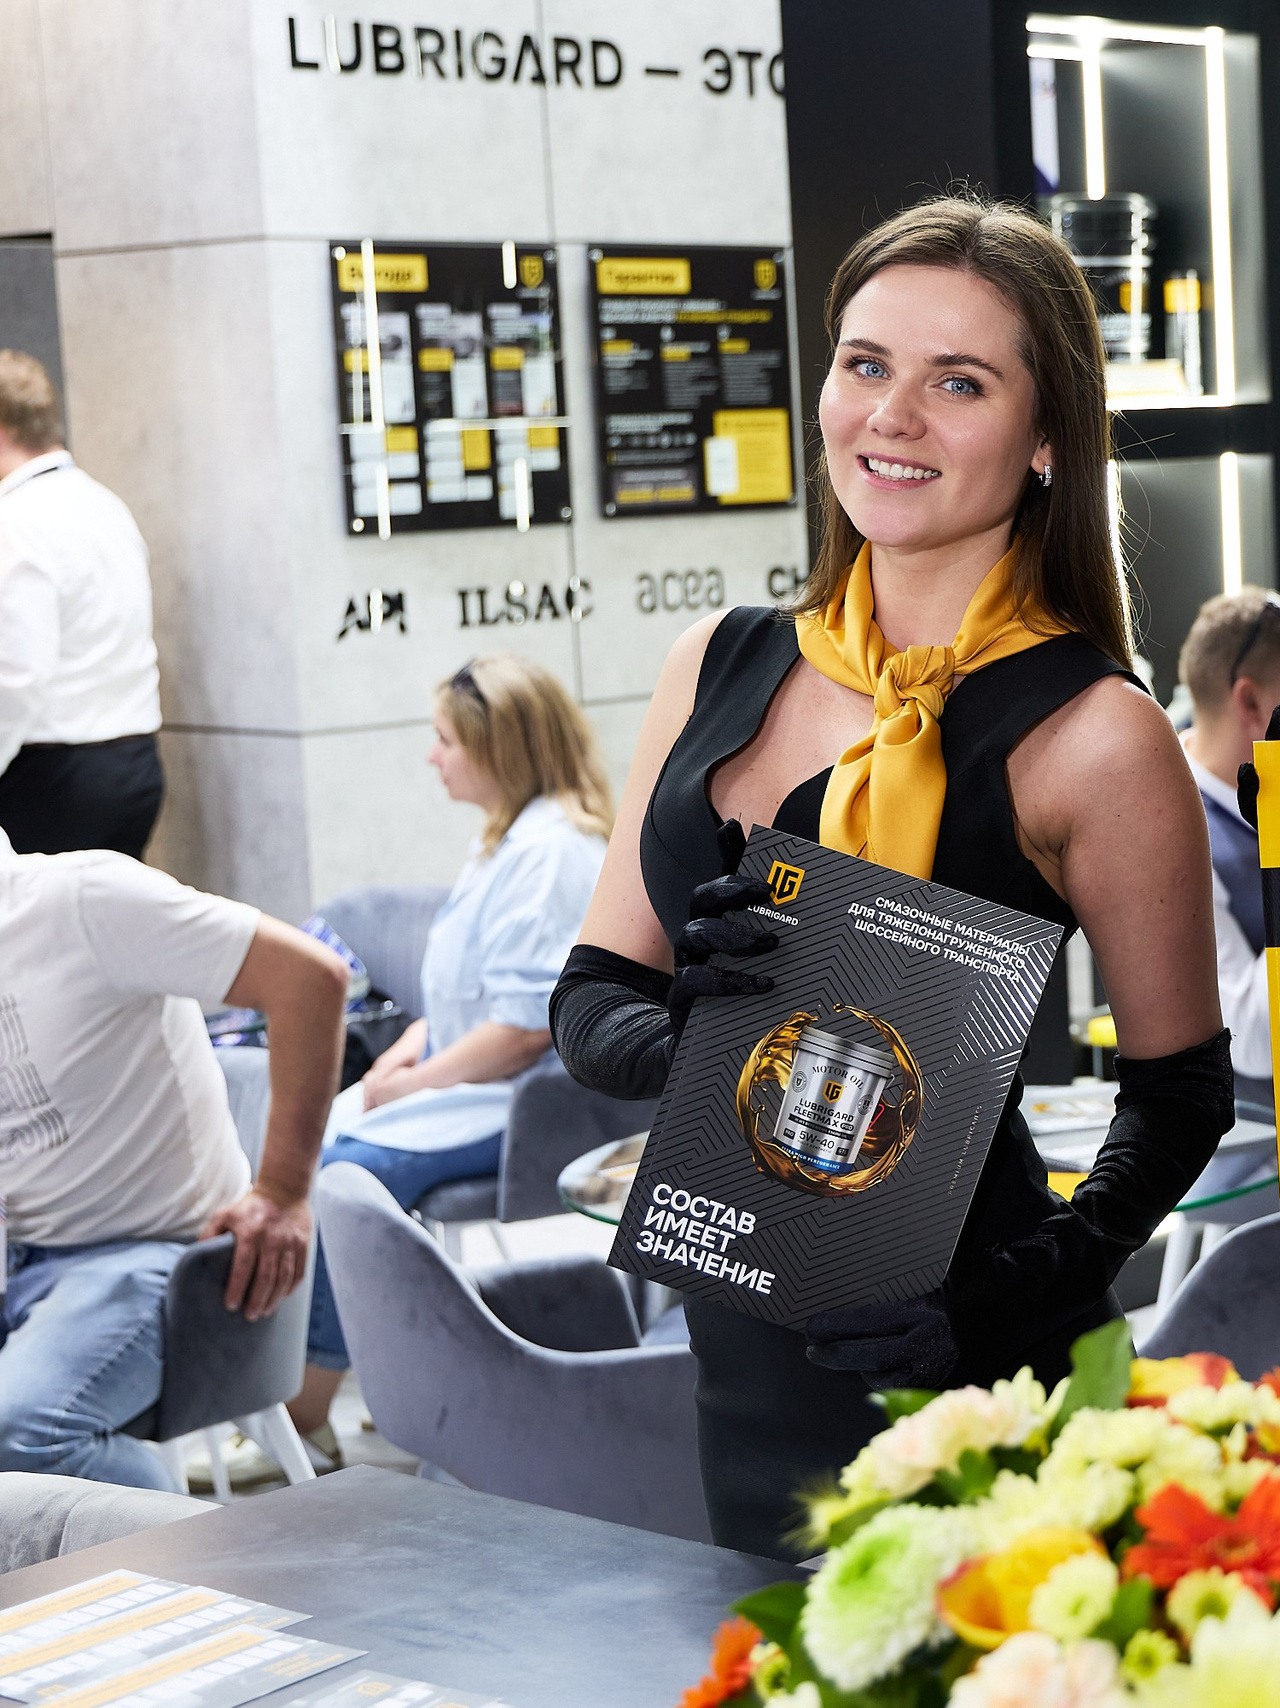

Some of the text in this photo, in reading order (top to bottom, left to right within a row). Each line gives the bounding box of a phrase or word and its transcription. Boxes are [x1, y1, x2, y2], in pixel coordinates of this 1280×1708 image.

[288, 16, 624, 88] LUBRIGARD
[457, 579, 594, 628] ILSAC
[635, 567, 725, 613] acea
[848, 902, 1026, 969] ДЛЯ ТЯЖЕЛОНАГРУЖЕННОГО
[854, 919, 1021, 983] ШОССЕЙНОГО ТРАНСПОРТА
[875, 897, 1031, 956] СМАЗОЧНЫЕ МАТЕРИАЛЫ
[812, 1065, 865, 1091] MOTOR OIL
[794, 1106, 839, 1128] FLEETMAX
[799, 1098, 855, 1122] LUBRIGARD
[799, 1130, 835, 1150] 5W-40
[644, 1205, 737, 1253] ИМЕЕТ
[652, 1183, 757, 1234] СОСТАВ
[636, 1230, 776, 1295] ЗНАЧЕНИЕ
